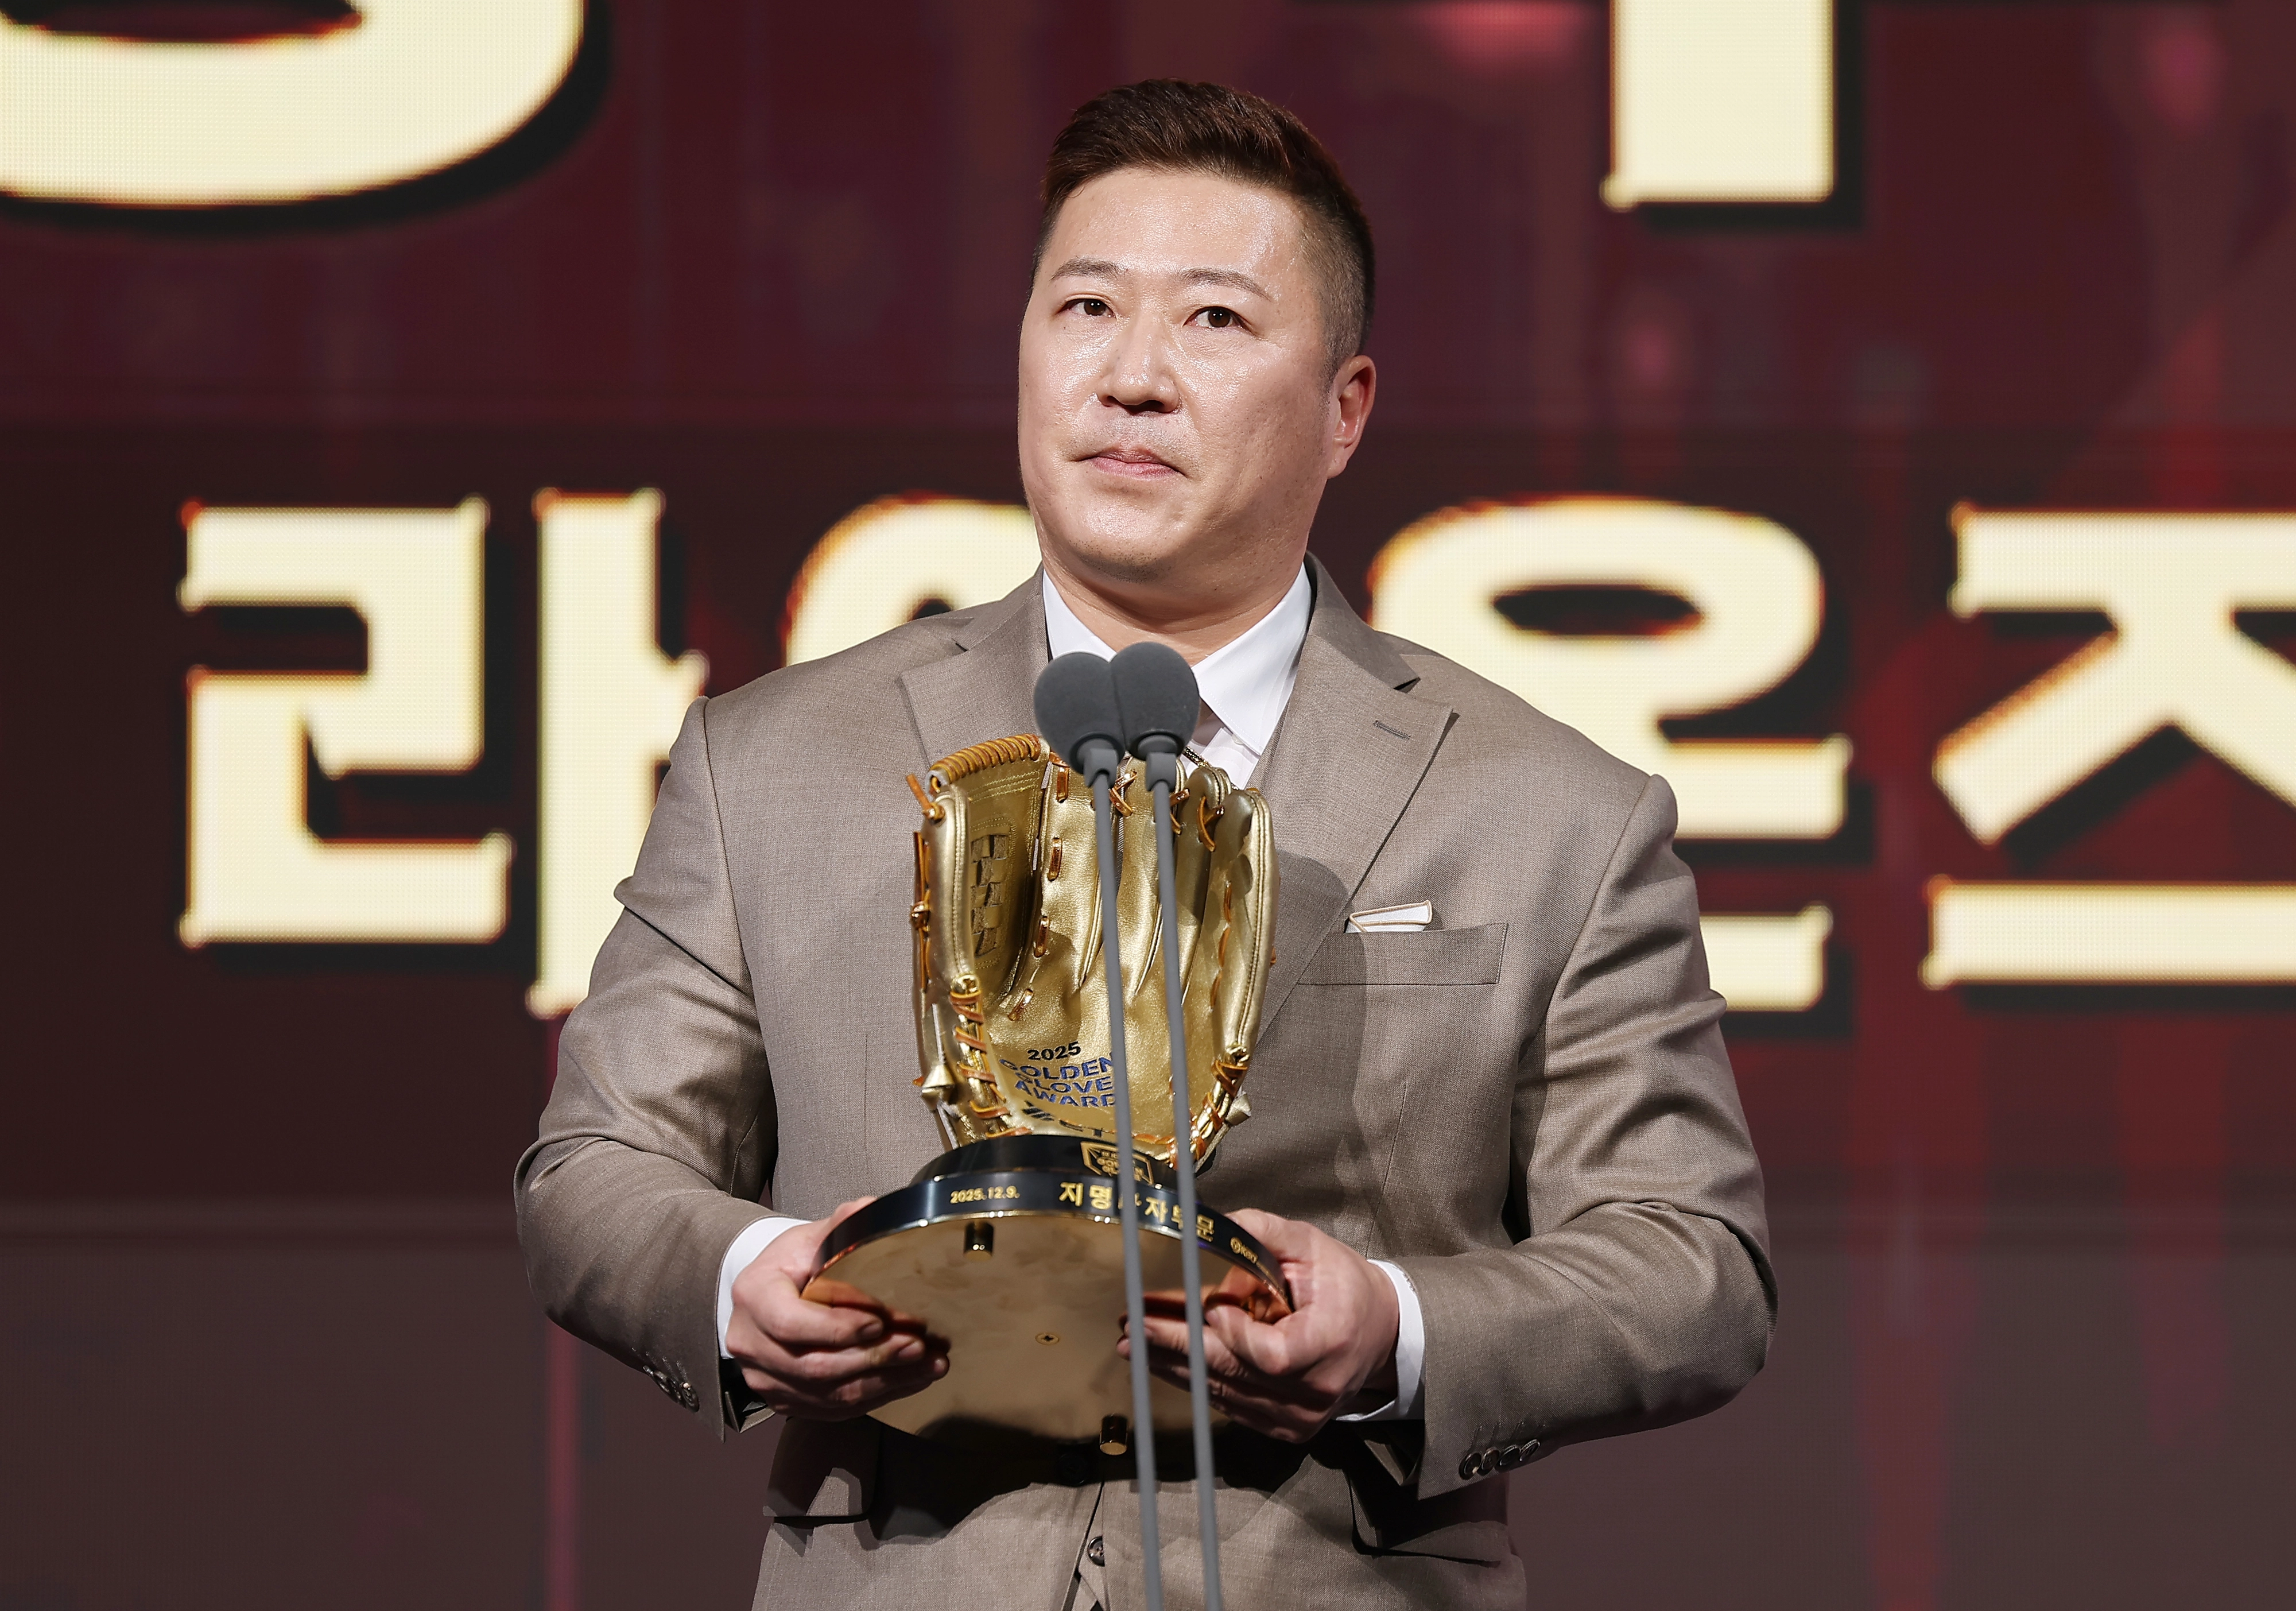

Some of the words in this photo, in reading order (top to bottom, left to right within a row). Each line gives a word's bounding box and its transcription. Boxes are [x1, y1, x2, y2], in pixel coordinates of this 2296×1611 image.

[179, 487, 2296, 1019] 라온즈
[1027, 1041, 1081, 1061] 2025
[999, 1052, 1114, 1080] GOLDEN
[1015, 1072, 1115, 1093] GLOVE
[1015, 1081, 1116, 1107] AWARD
